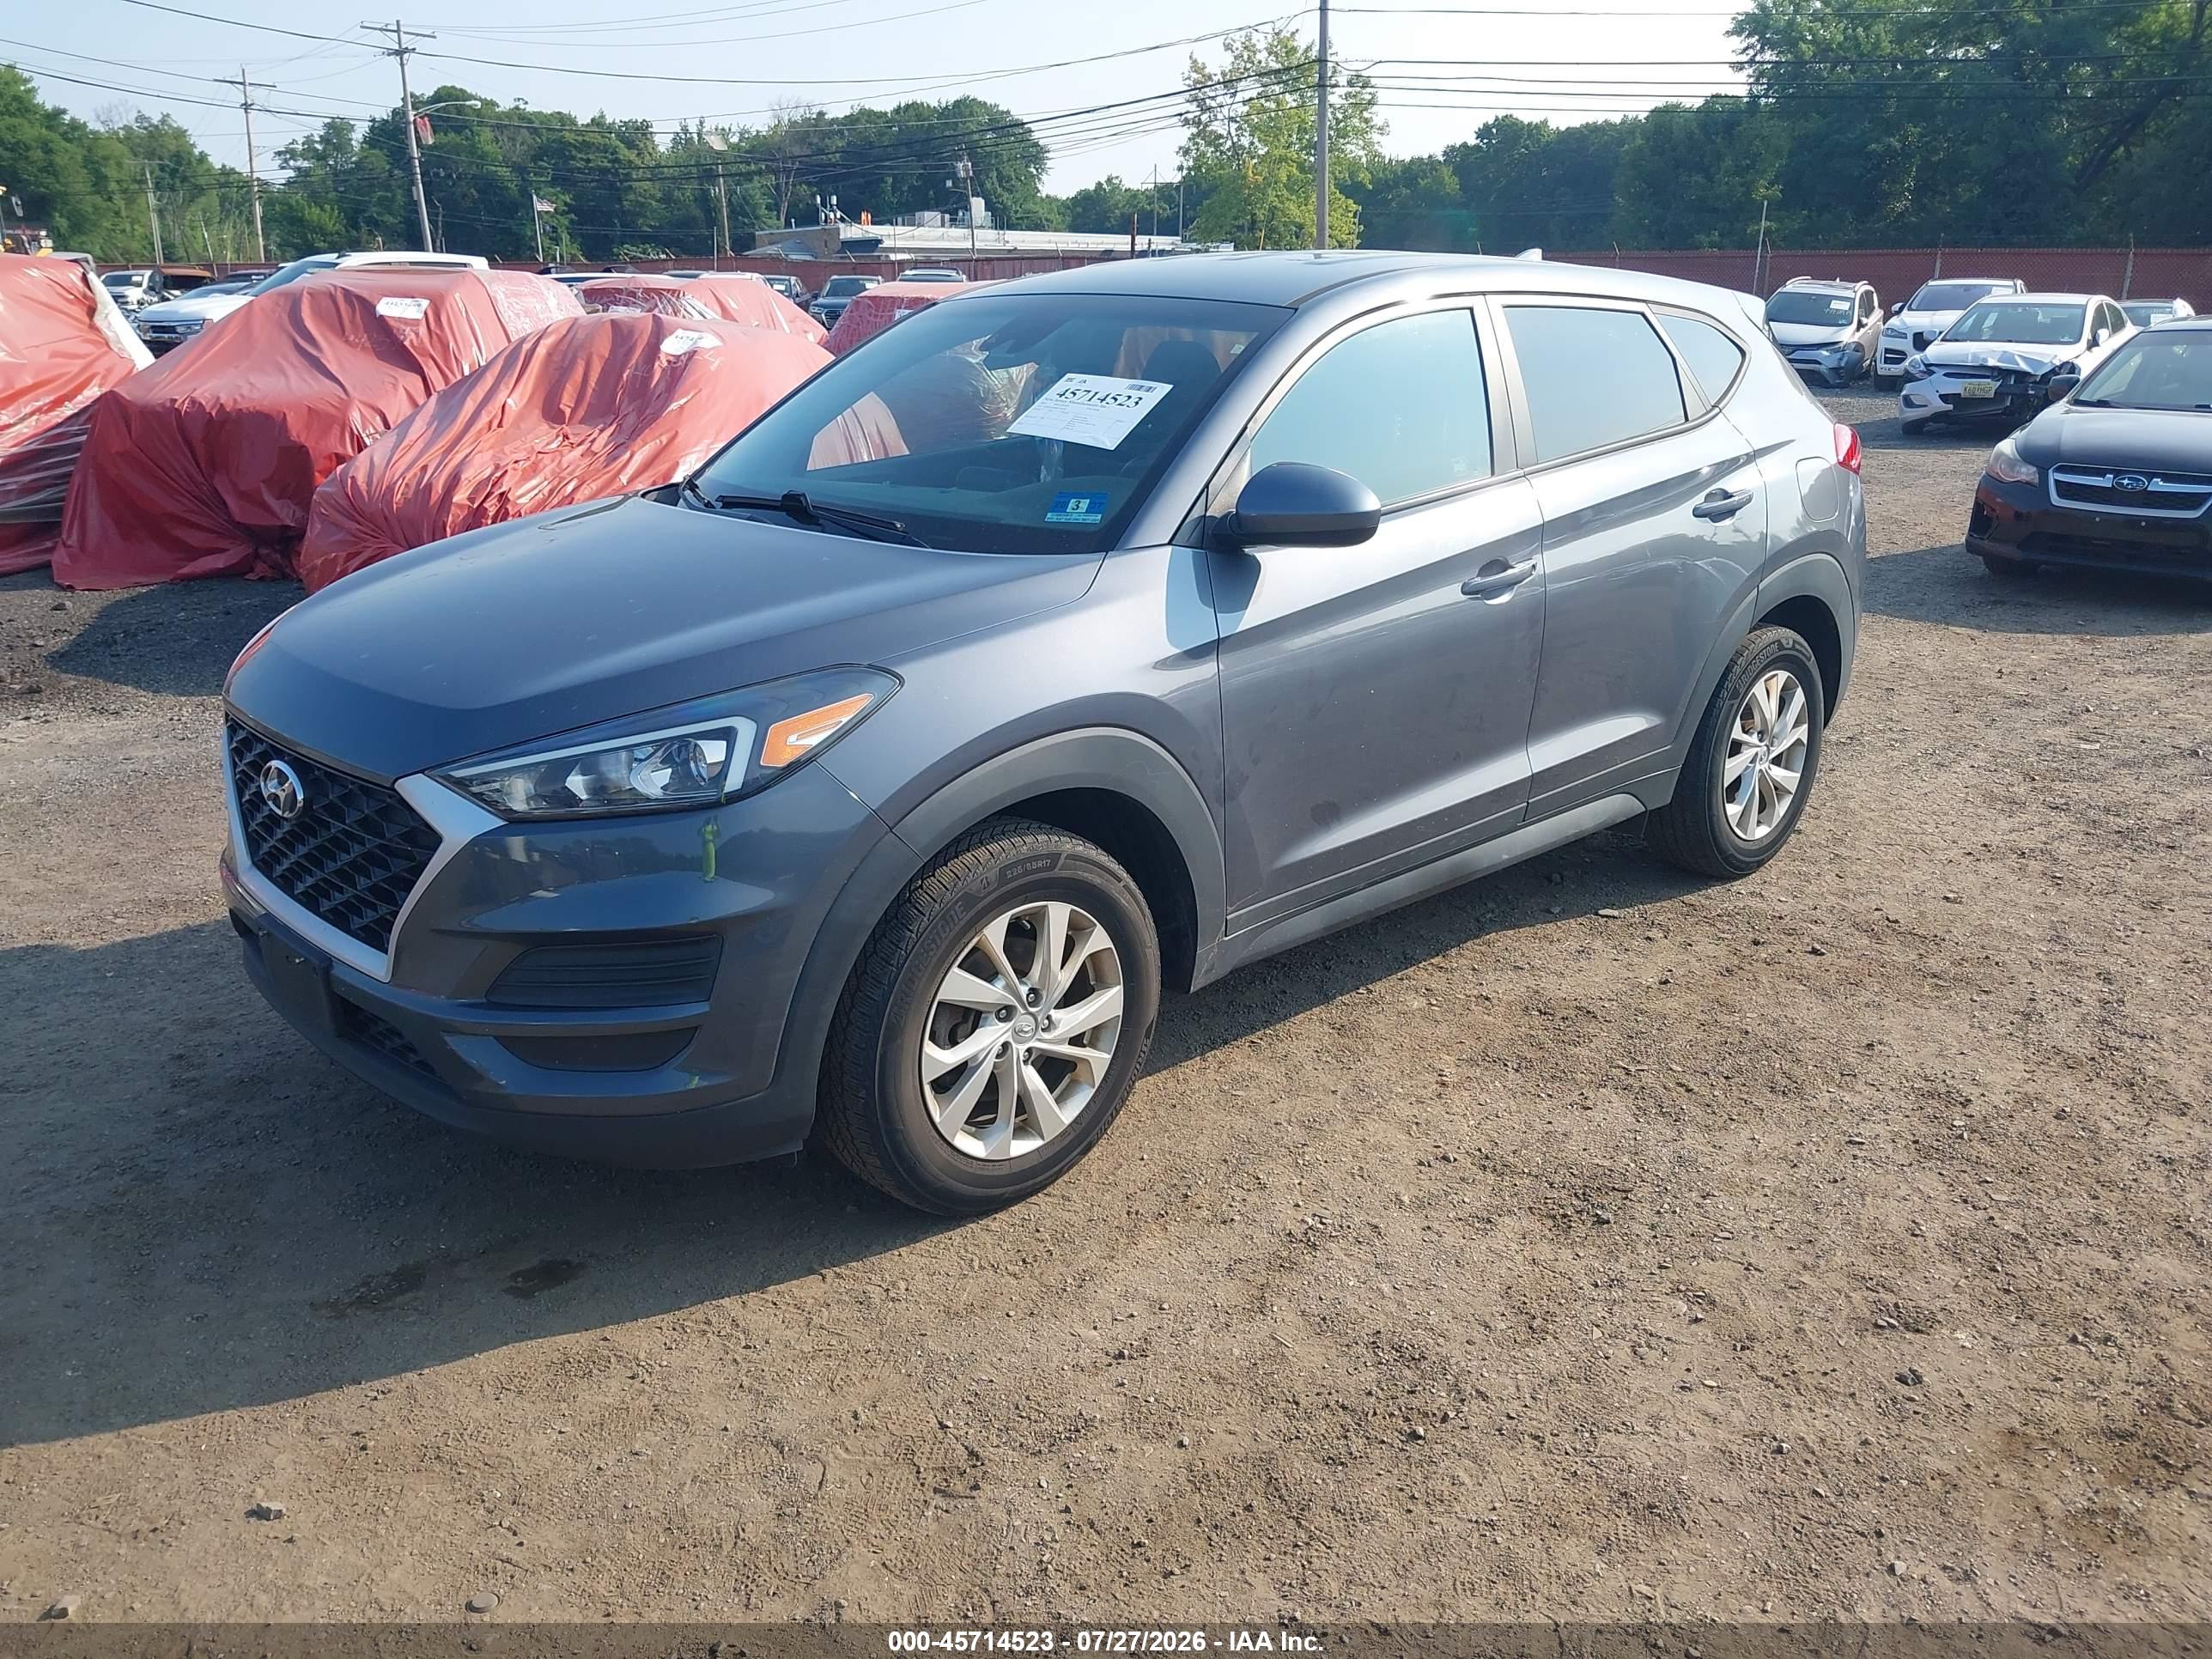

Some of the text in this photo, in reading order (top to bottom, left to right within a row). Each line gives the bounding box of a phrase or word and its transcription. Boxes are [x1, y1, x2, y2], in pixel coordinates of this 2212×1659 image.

[1055, 387, 1143, 409] 45714523
[1072, 500, 1081, 511] 3
[1735, 641, 1779, 695] BRIDGESTONE
